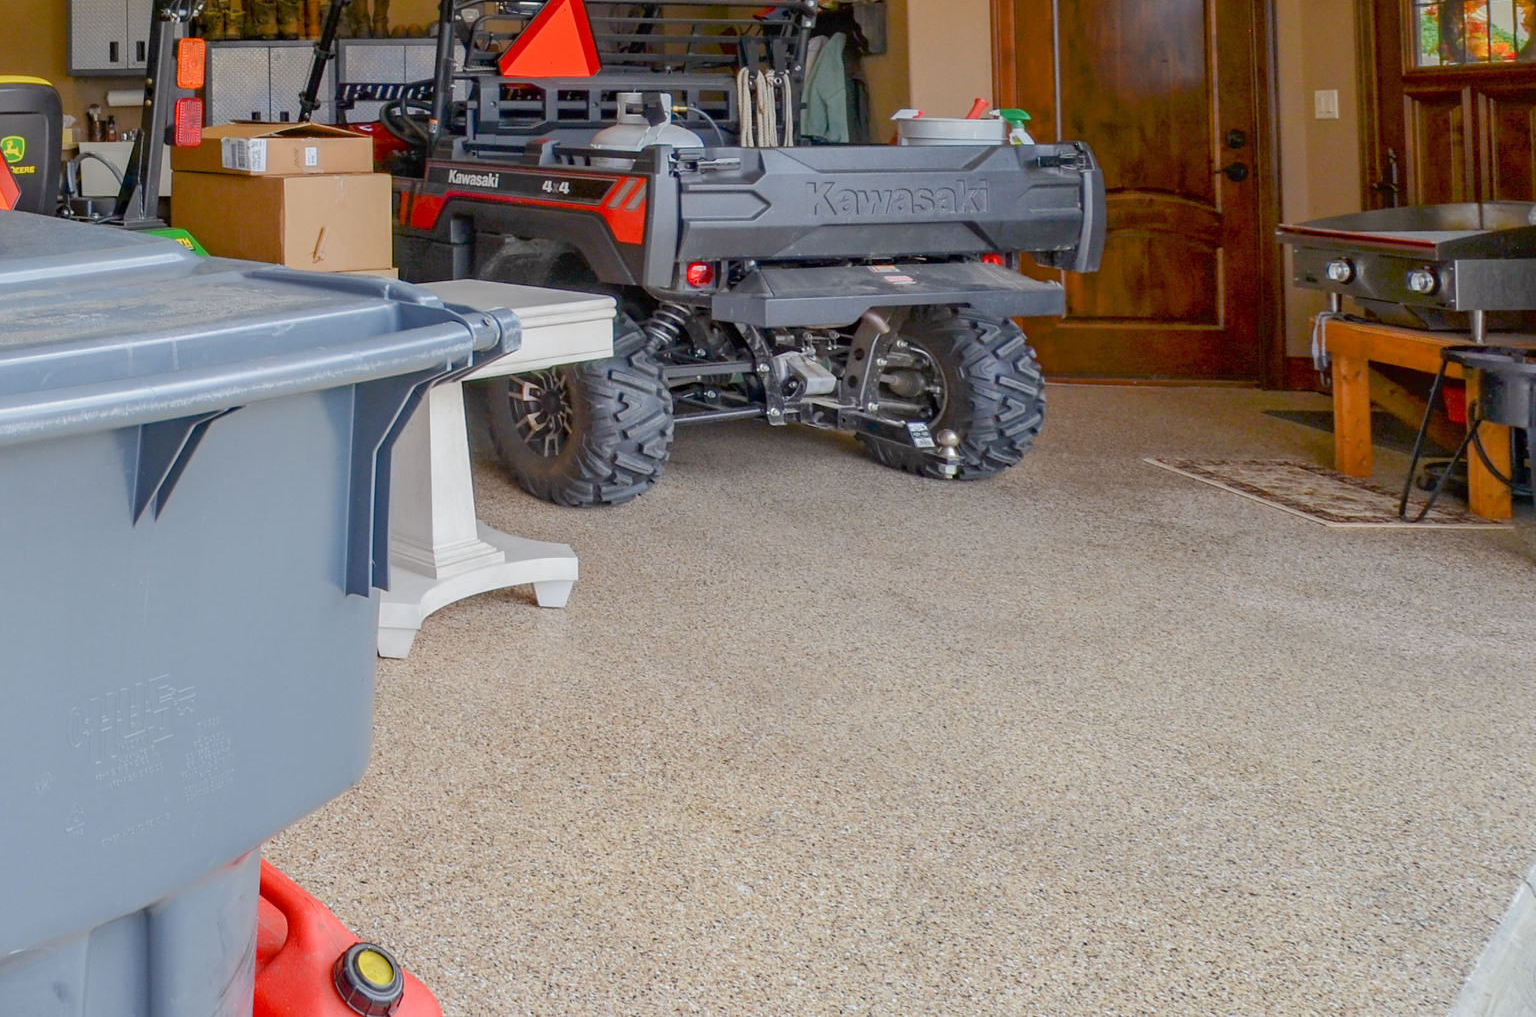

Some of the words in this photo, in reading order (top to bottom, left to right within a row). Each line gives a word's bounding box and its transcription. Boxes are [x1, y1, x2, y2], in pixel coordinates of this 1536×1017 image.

[448, 169, 500, 189] Kawasaki
[542, 180, 570, 195] 4x4
[805, 179, 990, 216] Kawasaki
